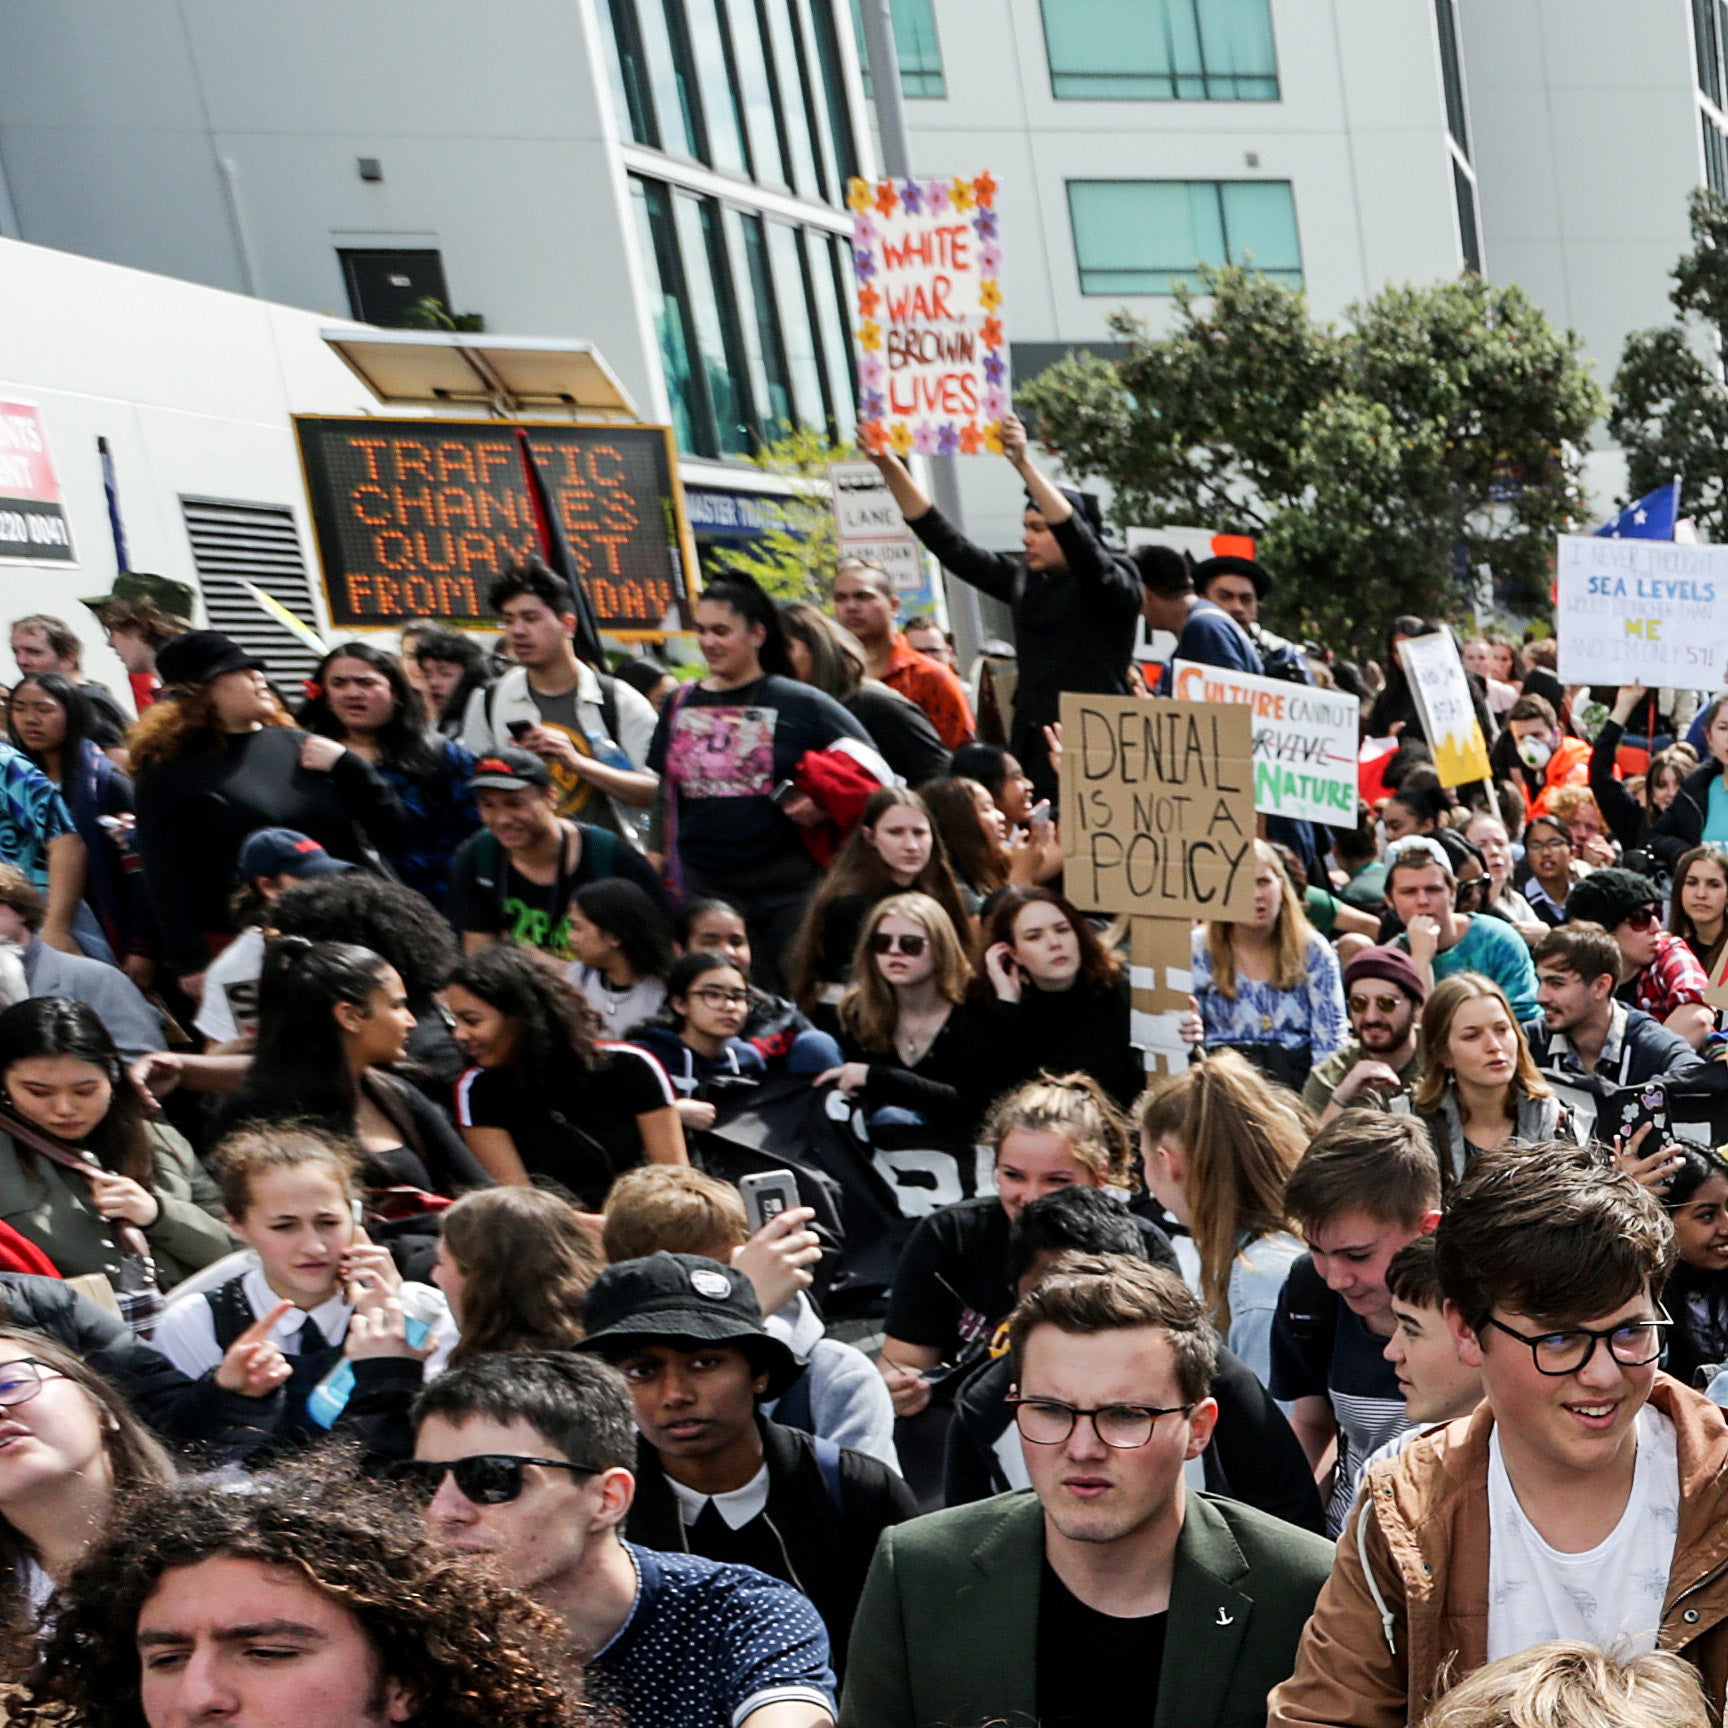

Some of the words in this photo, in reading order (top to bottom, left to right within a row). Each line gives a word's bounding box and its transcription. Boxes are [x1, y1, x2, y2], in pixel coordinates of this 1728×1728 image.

[880, 225, 970, 271] WHITE
[887, 328, 977, 371] BROWN
[890, 371, 979, 416] LIVES
[847, 508, 895, 528] LANE
[373, 529, 537, 575] QUAY
[1572, 543, 1584, 565] I
[1591, 544, 1640, 573] NEVER
[344, 572, 481, 618] FROM
[1588, 575, 1628, 598] SEA
[1636, 578, 1717, 603] LEVELS
[1624, 617, 1664, 642] ME
[1287, 699, 1356, 729] CANNOT
[1079, 707, 1241, 793] DENIAL
[1255, 761, 1356, 813] NATURE
[1077, 791, 1112, 832] IS
[1132, 792, 1192, 835] NOT
[1206, 798, 1242, 836] A
[1091, 831, 1251, 907] POLICY
